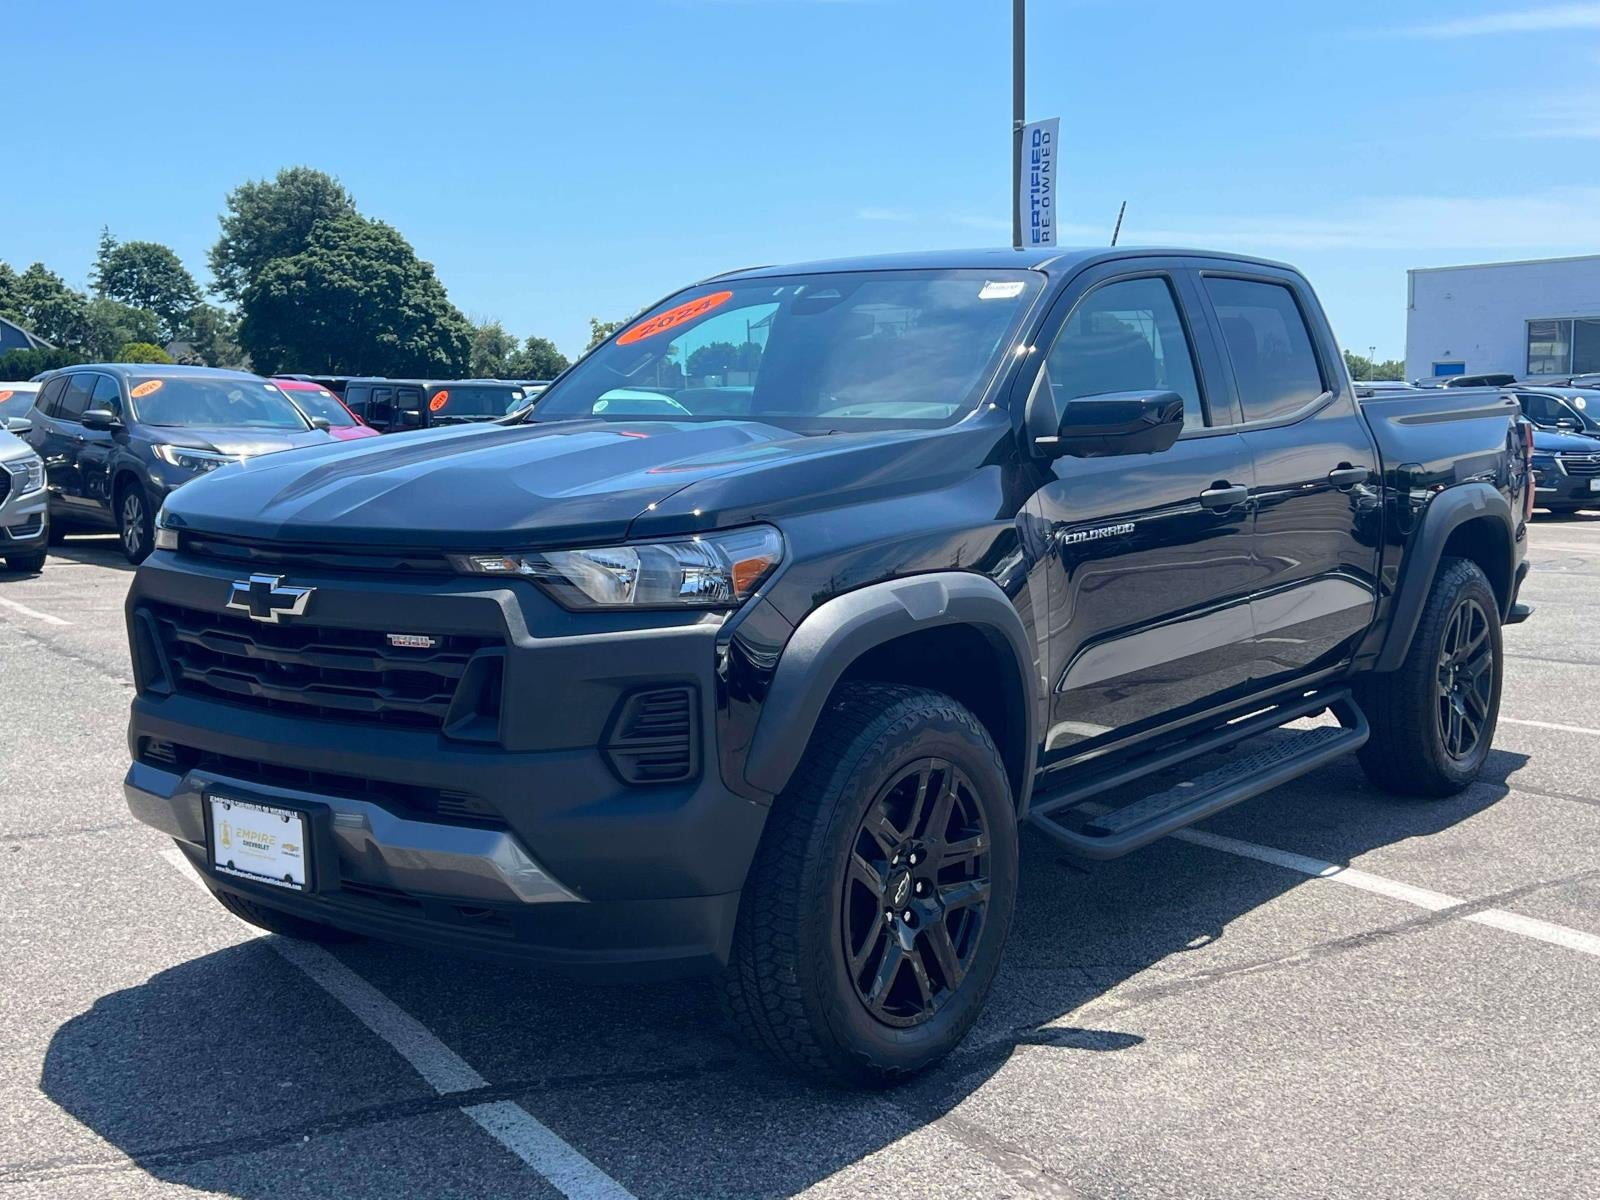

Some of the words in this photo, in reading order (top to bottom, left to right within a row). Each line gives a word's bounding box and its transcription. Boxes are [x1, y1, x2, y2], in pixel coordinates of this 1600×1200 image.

[1031, 129, 1041, 243] ERTIFIED
[1042, 132, 1051, 242] RE-OWNED
[639, 299, 712, 338] 2024
[1065, 523, 1135, 544] COLORADO
[236, 827, 277, 846] EMPIRE
[242, 840, 270, 851] CHEVROLET
